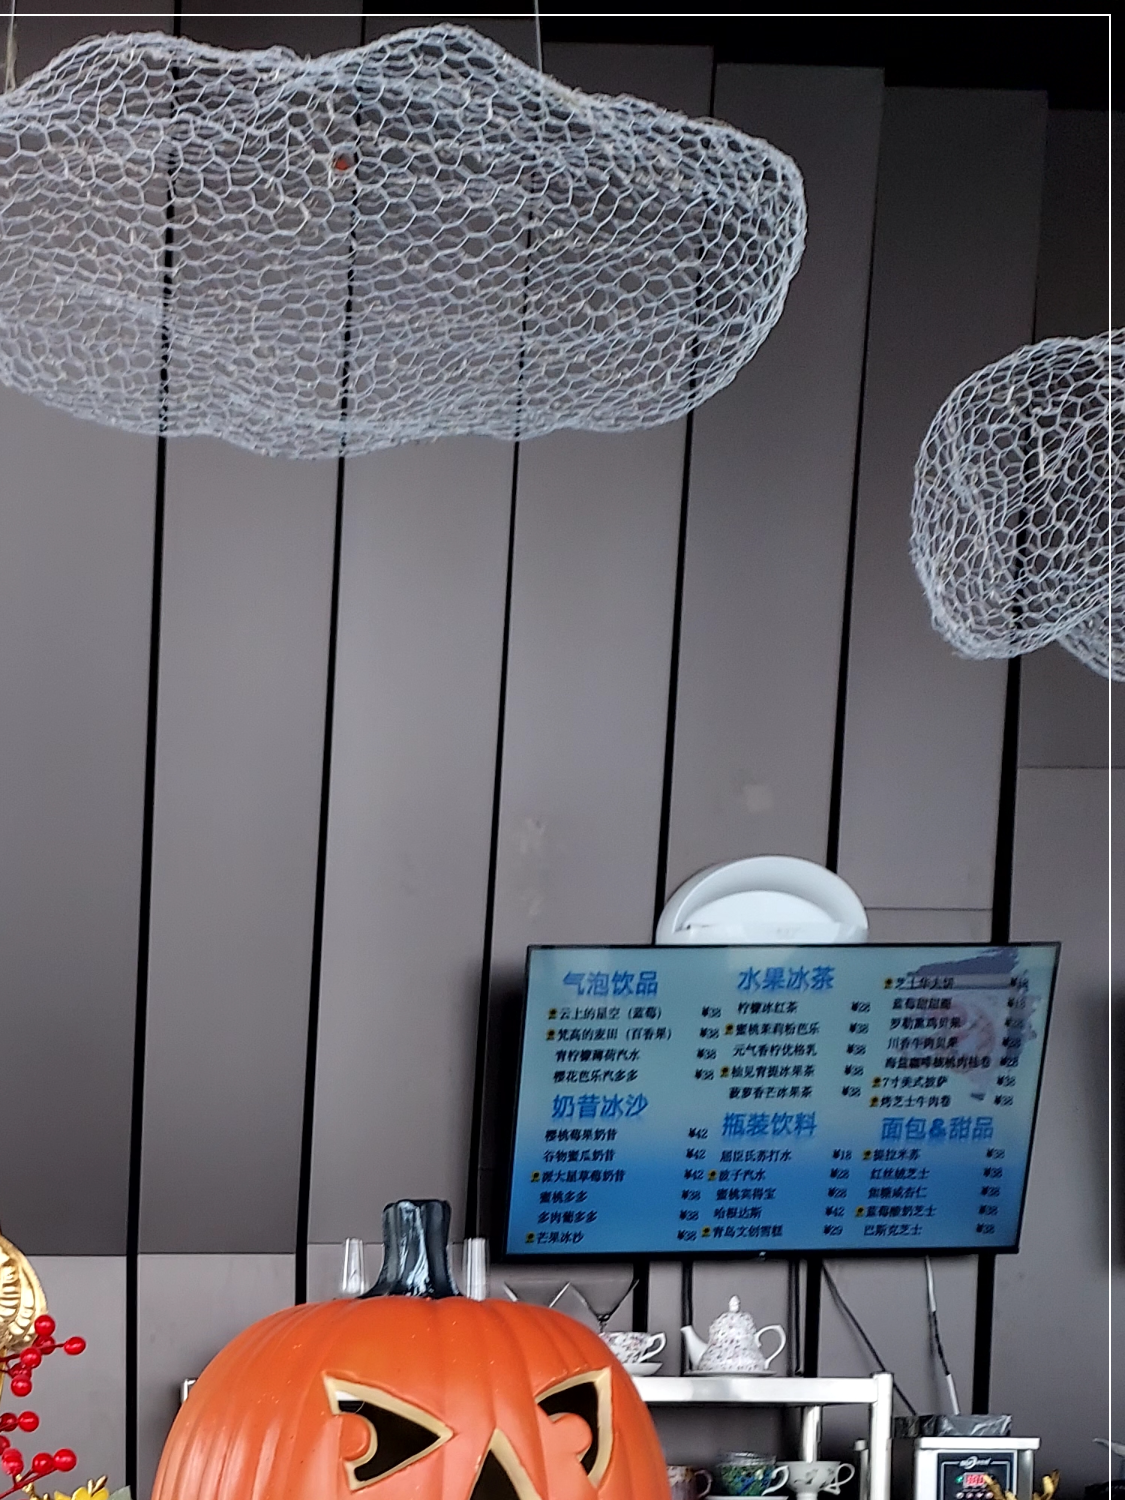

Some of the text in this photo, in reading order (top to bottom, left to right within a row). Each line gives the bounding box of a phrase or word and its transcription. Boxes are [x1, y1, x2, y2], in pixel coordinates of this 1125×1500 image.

[563, 970, 658, 996] 气泡饮品
[737, 965, 835, 991] 水果冰茶
[737, 1001, 798, 1015] 柠檬冰红茶
[555, 1049, 640, 1062] 青柠檬薄荷汽水
[551, 1093, 649, 1119] 奶昔冰沙
[721, 1111, 817, 1136] 瓶装饮料
[881, 1116, 994, 1140] 面包&甜品
[688, 1127, 708, 1139] ¥42
[543, 1148, 706, 1163] 谷物蜜瓜奶昔 ¥42
[720, 1149, 852, 1163] 屈臣氏苏打水 ¥18
[873, 1149, 921, 1161] 提拉米苏
[684, 1168, 704, 1180] ¥42
[539, 1190, 588, 1204] 蜜桃多多
[713, 1206, 845, 1220] 哈根达斯 ¥42
[537, 1231, 584, 1244] 芒果冰沙
[864, 1224, 923, 1237] 巴斯克芝士
